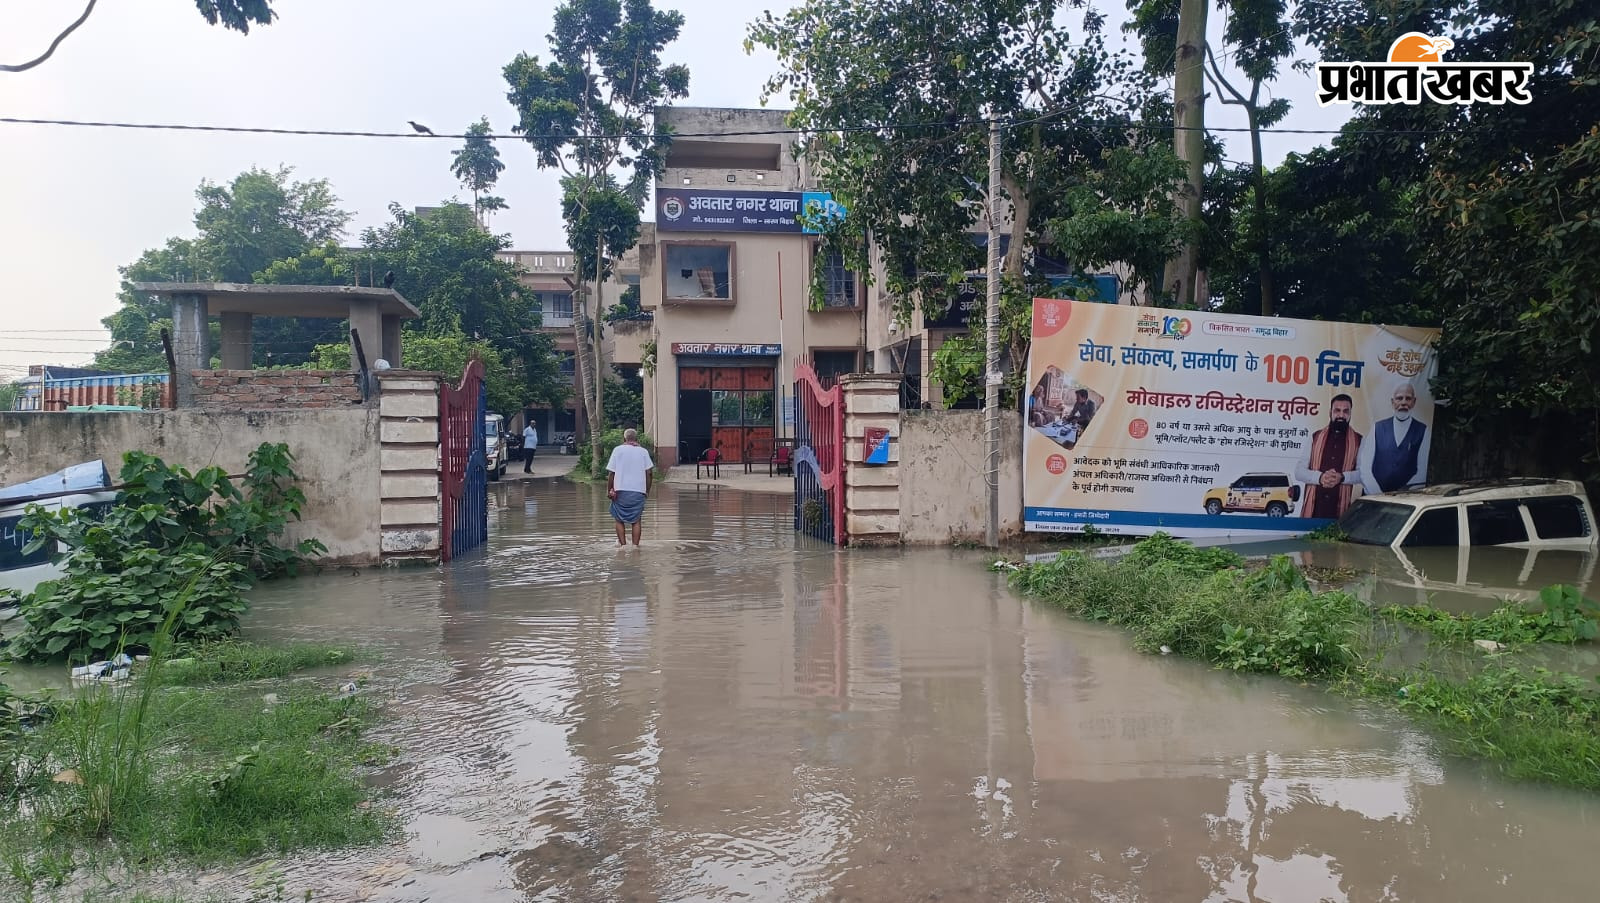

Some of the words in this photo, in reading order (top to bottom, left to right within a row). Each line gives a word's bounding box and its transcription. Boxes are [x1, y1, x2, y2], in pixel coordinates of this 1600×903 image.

[689, 196, 733, 211] अवतार
[735, 198, 768, 212] नगर
[769, 199, 799, 212] थाना
[1272, 327, 1289, 337] बिहार
[678, 343, 712, 354] अवतार
[714, 344, 739, 354] नगर
[741, 344, 764, 354] थाना
[1078, 338, 1117, 367] सेवा,
[1120, 343, 1178, 371] संकल्प,
[1182, 348, 1238, 372] समर्पण
[1245, 351, 1259, 372] के
[1264, 354, 1309, 385] 100
[1315, 350, 1365, 388] दिन
[1126, 387, 1192, 409] मोबाइल
[1195, 391, 1273, 414] रजिस्ट्रेशन
[1277, 397, 1320, 420] यूनिट
[1183, 423, 1191, 431] या
[1193, 422, 1211, 432] उससे
[1213, 423, 1235, 433] अधिक
[1237, 426, 1251, 437] आयु
[1254, 425, 1261, 434] के
[1299, 428, 1309, 438] को
[1208, 436, 1216, 445] के
[1270, 439, 1279, 448] की
[1281, 440, 1302, 451] सुविधा
[1073, 456, 1100, 466] आवेदक
[1101, 457, 1112, 466] को
[1114, 458, 1127, 469] भूमि
[1150, 461, 1189, 470] आधिकारिक
[1191, 463, 1220, 472] जानकारी
[1073, 470, 1093, 478] अंचल
[1151, 473, 1181, 483] अधिकारी
[1182, 474, 1189, 484] से
[1190, 475, 1214, 484] निबंधन
[1072, 482, 1080, 491] के
[1081, 482, 1092, 493] पूर्व
[1093, 483, 1109, 492] होगी
[1110, 485, 1135, 493] उपलब्ध
